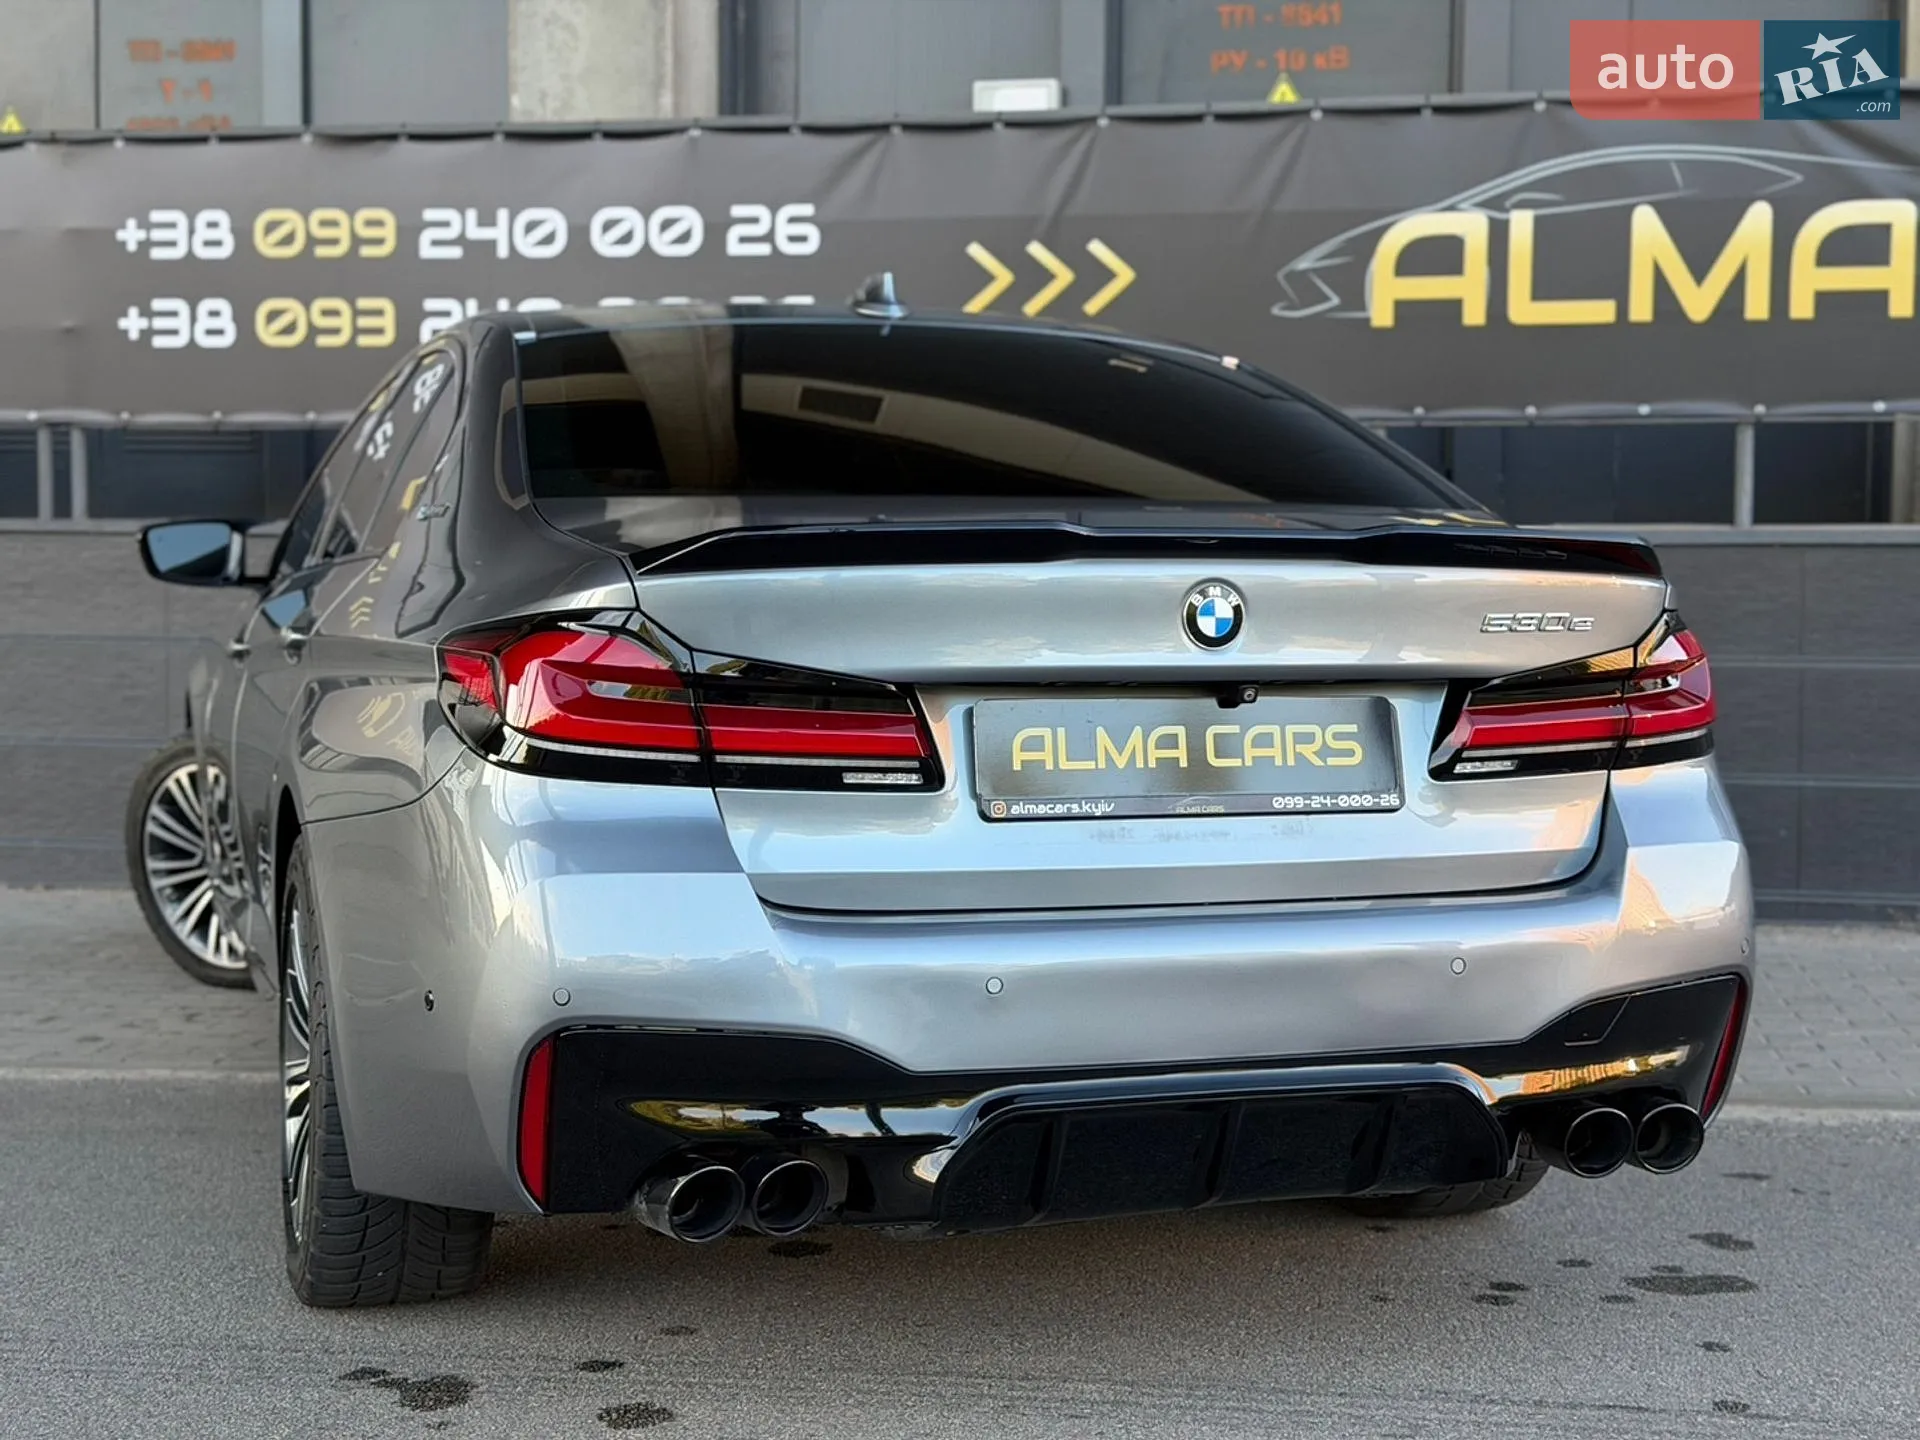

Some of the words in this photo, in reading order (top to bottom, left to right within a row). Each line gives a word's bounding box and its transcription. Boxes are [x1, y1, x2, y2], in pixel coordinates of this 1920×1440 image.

[116, 209, 235, 260] +38
[253, 208, 397, 259] 099
[418, 207, 569, 260] 240
[589, 205, 704, 258] 00
[726, 203, 821, 257] 26
[1369, 199, 1918, 328] ALMA
[118, 297, 237, 349] +38
[255, 297, 397, 348] 093
[1190, 586, 1241, 607] BMW
[1480, 612, 1595, 633] 530e
[1012, 724, 1189, 771] ALMA
[1205, 723, 1363, 768] CARS
[1010, 800, 1116, 816] almacars.kyiv
[1272, 794, 1400, 809] 099-24-000-26
